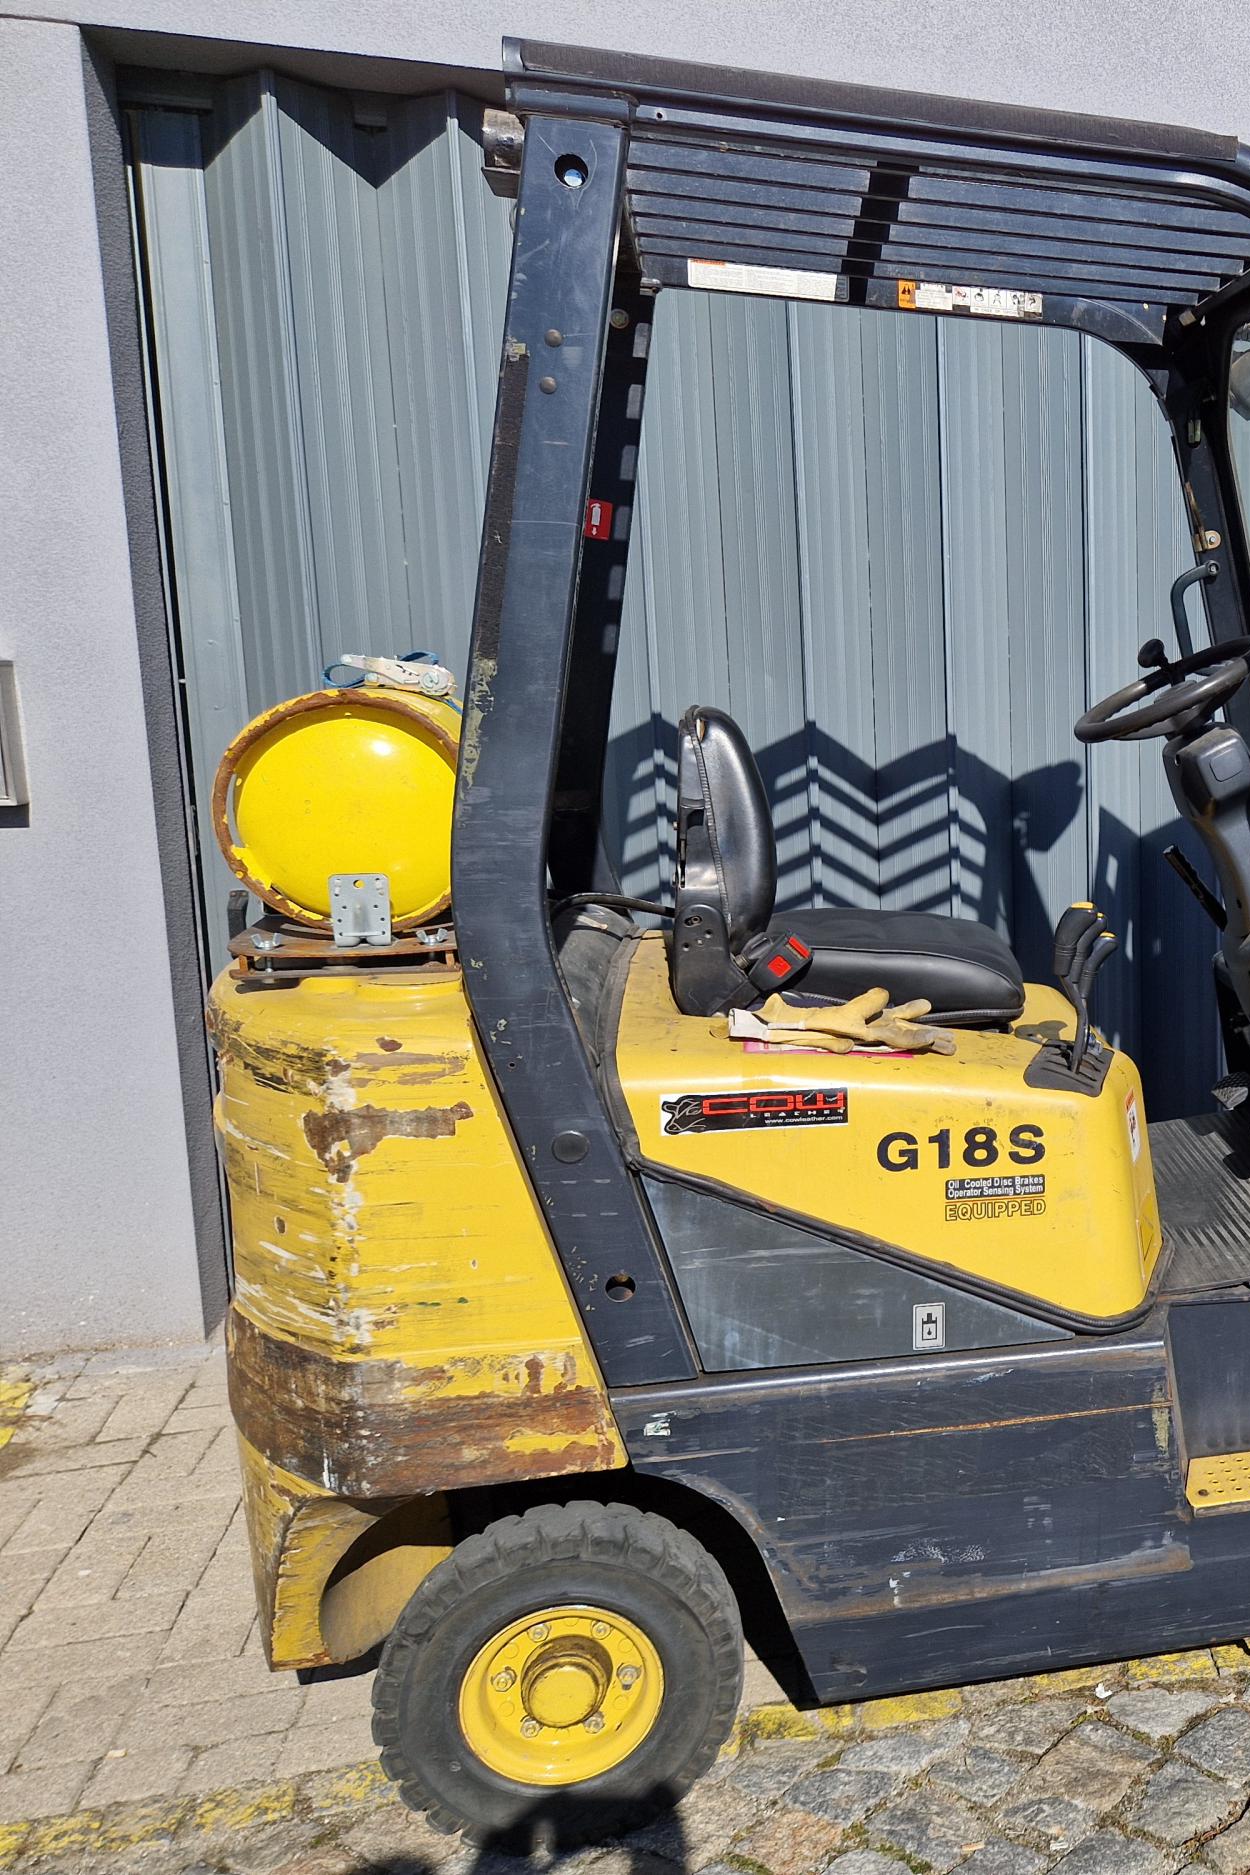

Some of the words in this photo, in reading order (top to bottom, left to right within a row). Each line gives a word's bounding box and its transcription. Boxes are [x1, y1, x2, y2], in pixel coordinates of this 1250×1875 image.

[703, 1092, 844, 1115] COW
[764, 1115, 844, 1124] www.cowleather.com
[876, 1124, 1046, 1172] G18S
[948, 1180, 960, 1189] Oil
[964, 1179, 992, 1188] Cooled
[994, 1177, 1013, 1187] Disc
[1015, 1176, 1044, 1185] Brakes
[948, 1188, 982, 1199] Operator
[983, 1186, 1014, 1196] Sensing
[1015, 1184, 1044, 1195] System
[945, 1198, 1047, 1222] EQUIPPED
